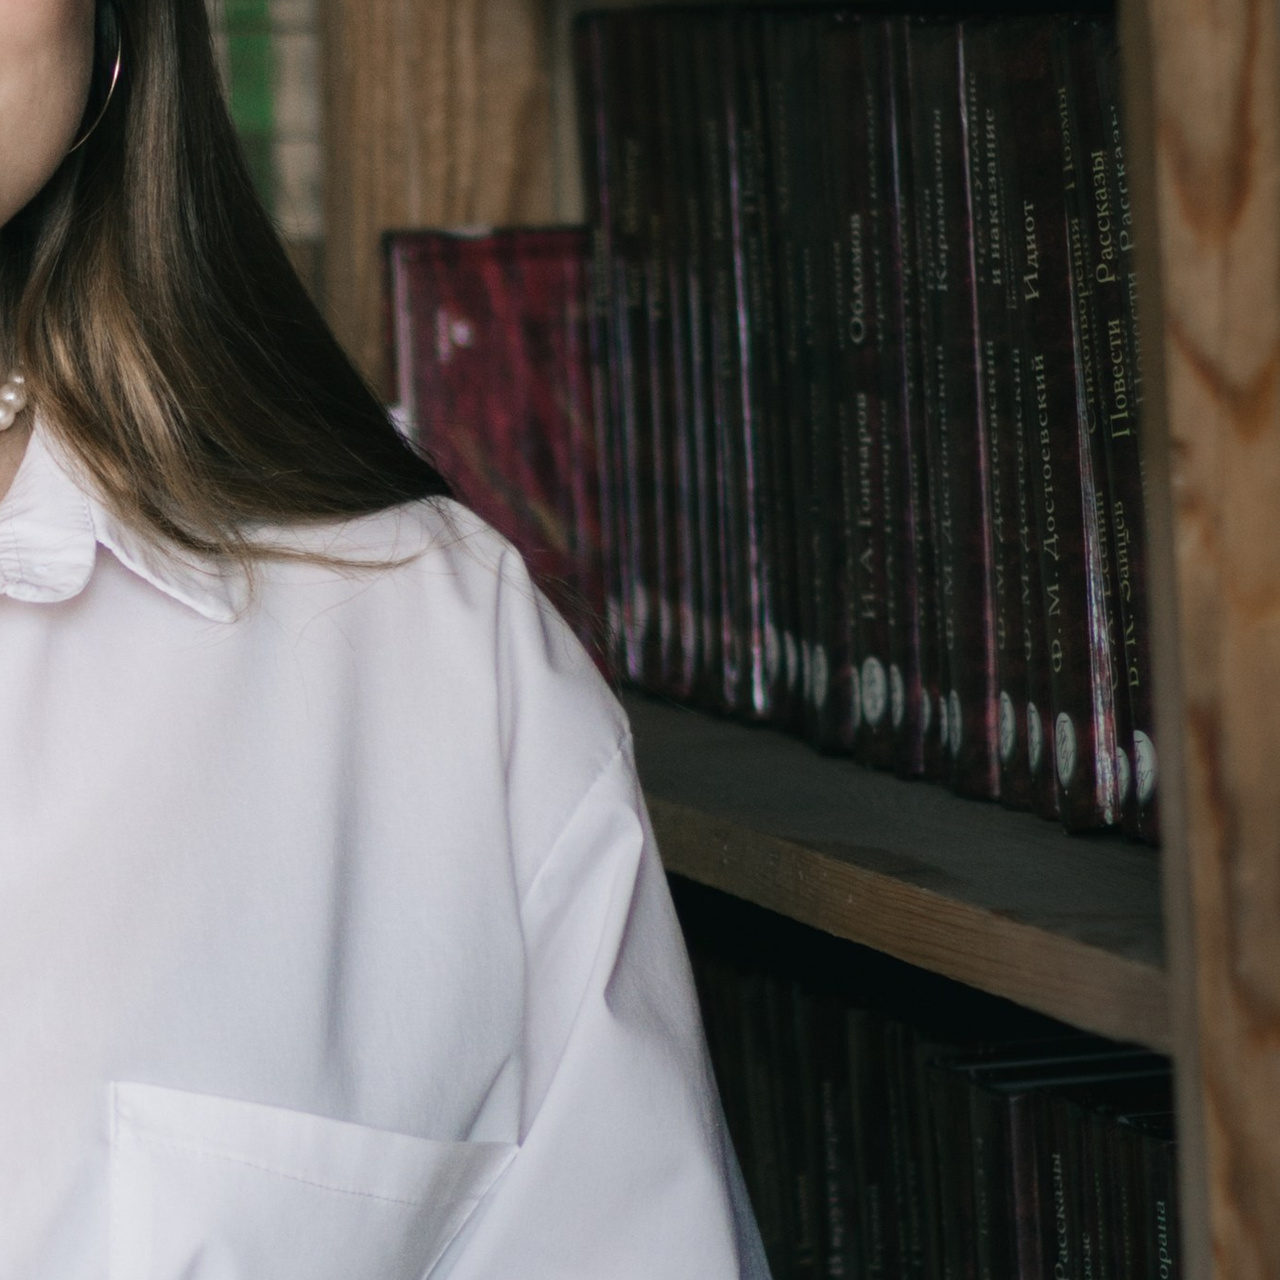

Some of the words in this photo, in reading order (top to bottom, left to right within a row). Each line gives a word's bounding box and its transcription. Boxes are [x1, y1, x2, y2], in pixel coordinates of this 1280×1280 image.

[932, 107, 949, 292] Карамазовы
[984, 106, 1001, 260] наказание
[1057, 86, 1077, 192] Поэмы
[848, 213, 868, 346] Обломов
[990, 268, 1002, 286] и
[1022, 199, 1041, 301] Идиот
[1091, 150, 1116, 285] Рассказы
[1070, 217, 1096, 436] Стихотворения
[1107, 319, 1131, 439] Повести
[855, 390, 874, 529] Гончаров
[1030, 353, 1061, 562] Достоевский
[1046, 570, 1061, 618] М.
[1049, 627, 1063, 674] Ф.
